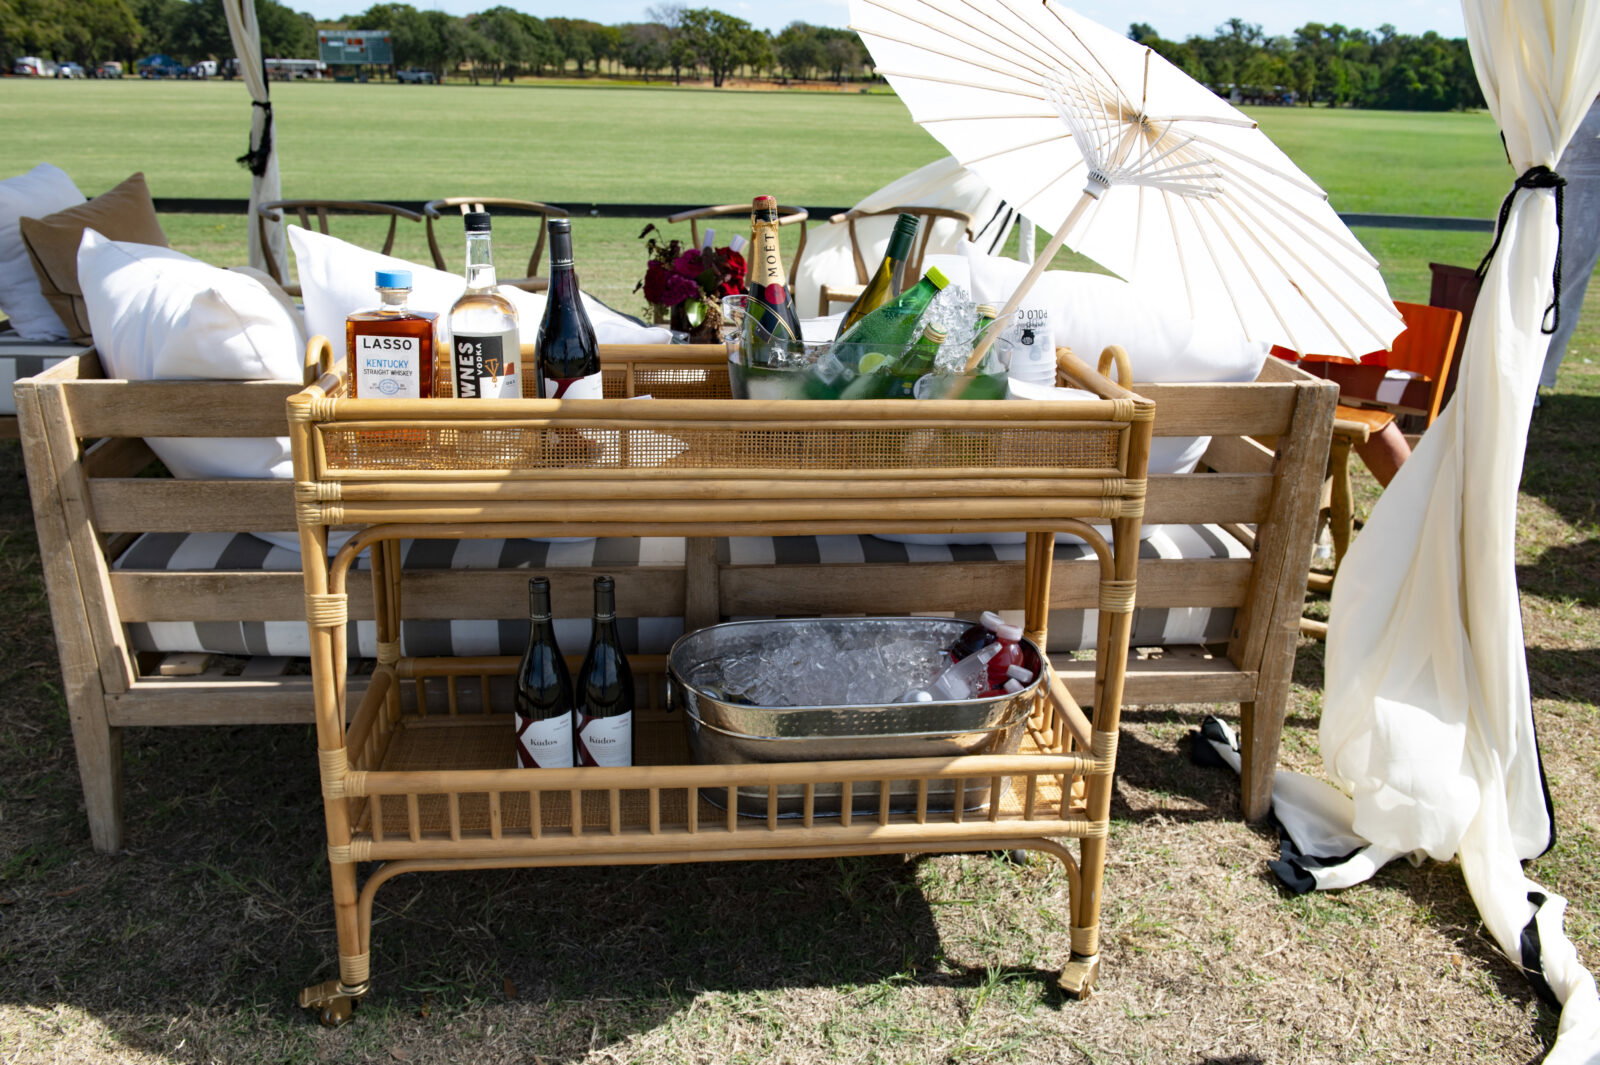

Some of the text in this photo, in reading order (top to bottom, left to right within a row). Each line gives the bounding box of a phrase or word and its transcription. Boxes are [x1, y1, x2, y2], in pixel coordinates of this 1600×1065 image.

[764, 233, 779, 278] MOËT
[1027, 309, 1048, 320] POLO
[363, 338, 412, 350] LASSO
[366, 359, 409, 368] KENTUCKY
[475, 343, 483, 375] VODKA
